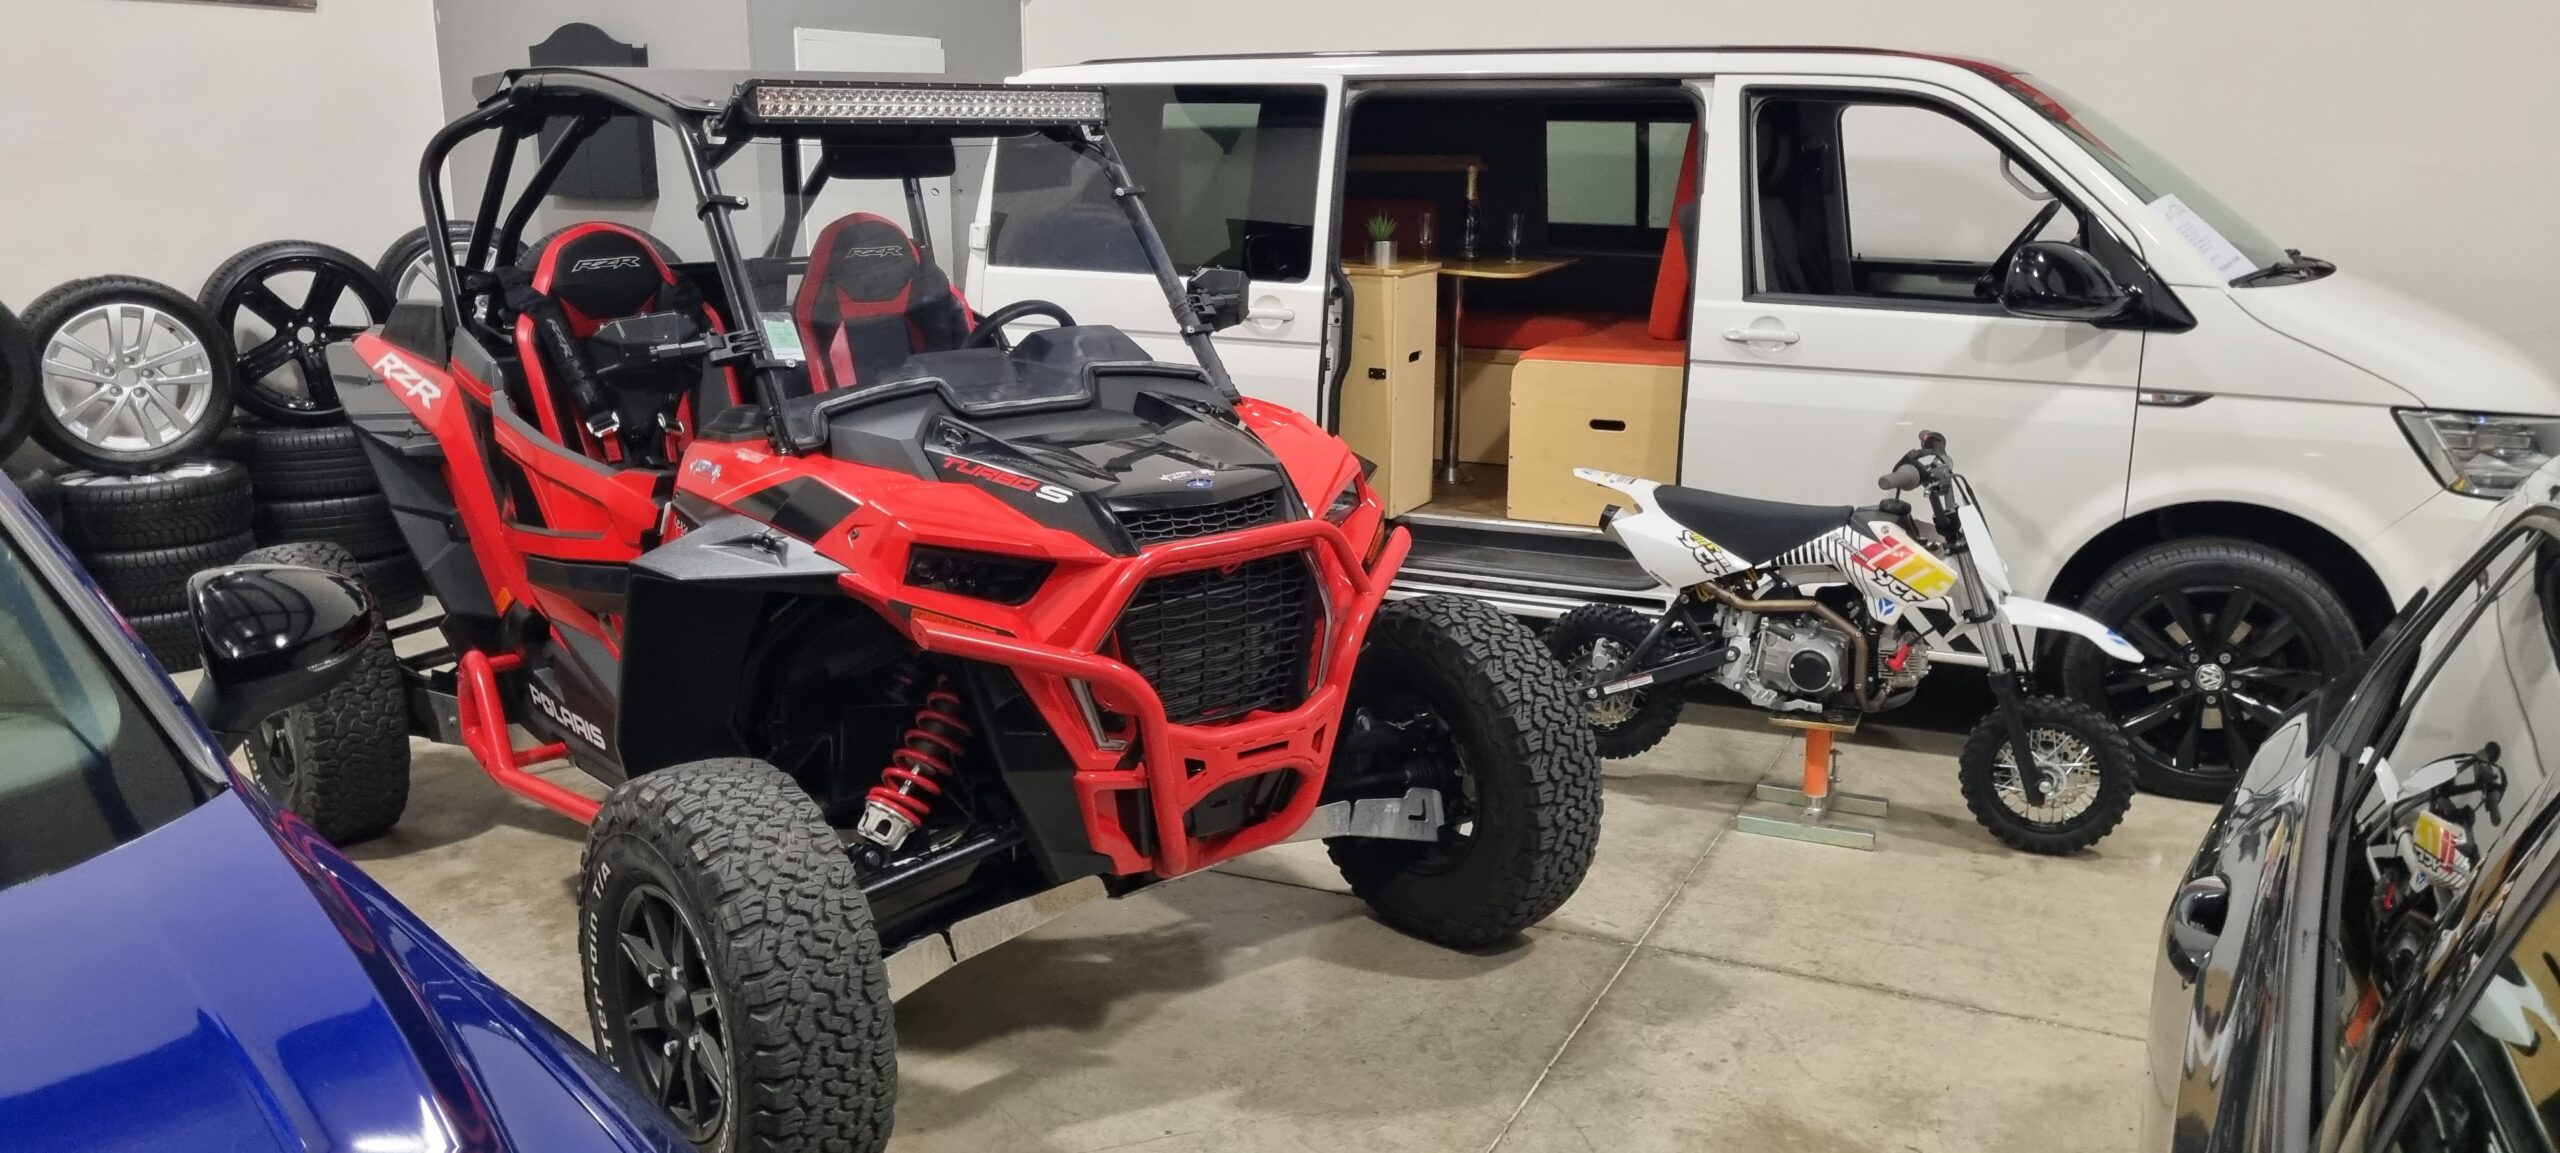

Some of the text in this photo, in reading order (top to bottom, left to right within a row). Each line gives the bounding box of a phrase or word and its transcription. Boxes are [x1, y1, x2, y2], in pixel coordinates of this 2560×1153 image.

[571, 256, 641, 272] RZR
[845, 246, 903, 260] RZR
[373, 352, 442, 410] RZR
[942, 455, 1074, 504] TURBO S
[528, 682, 606, 751] POLARIS
